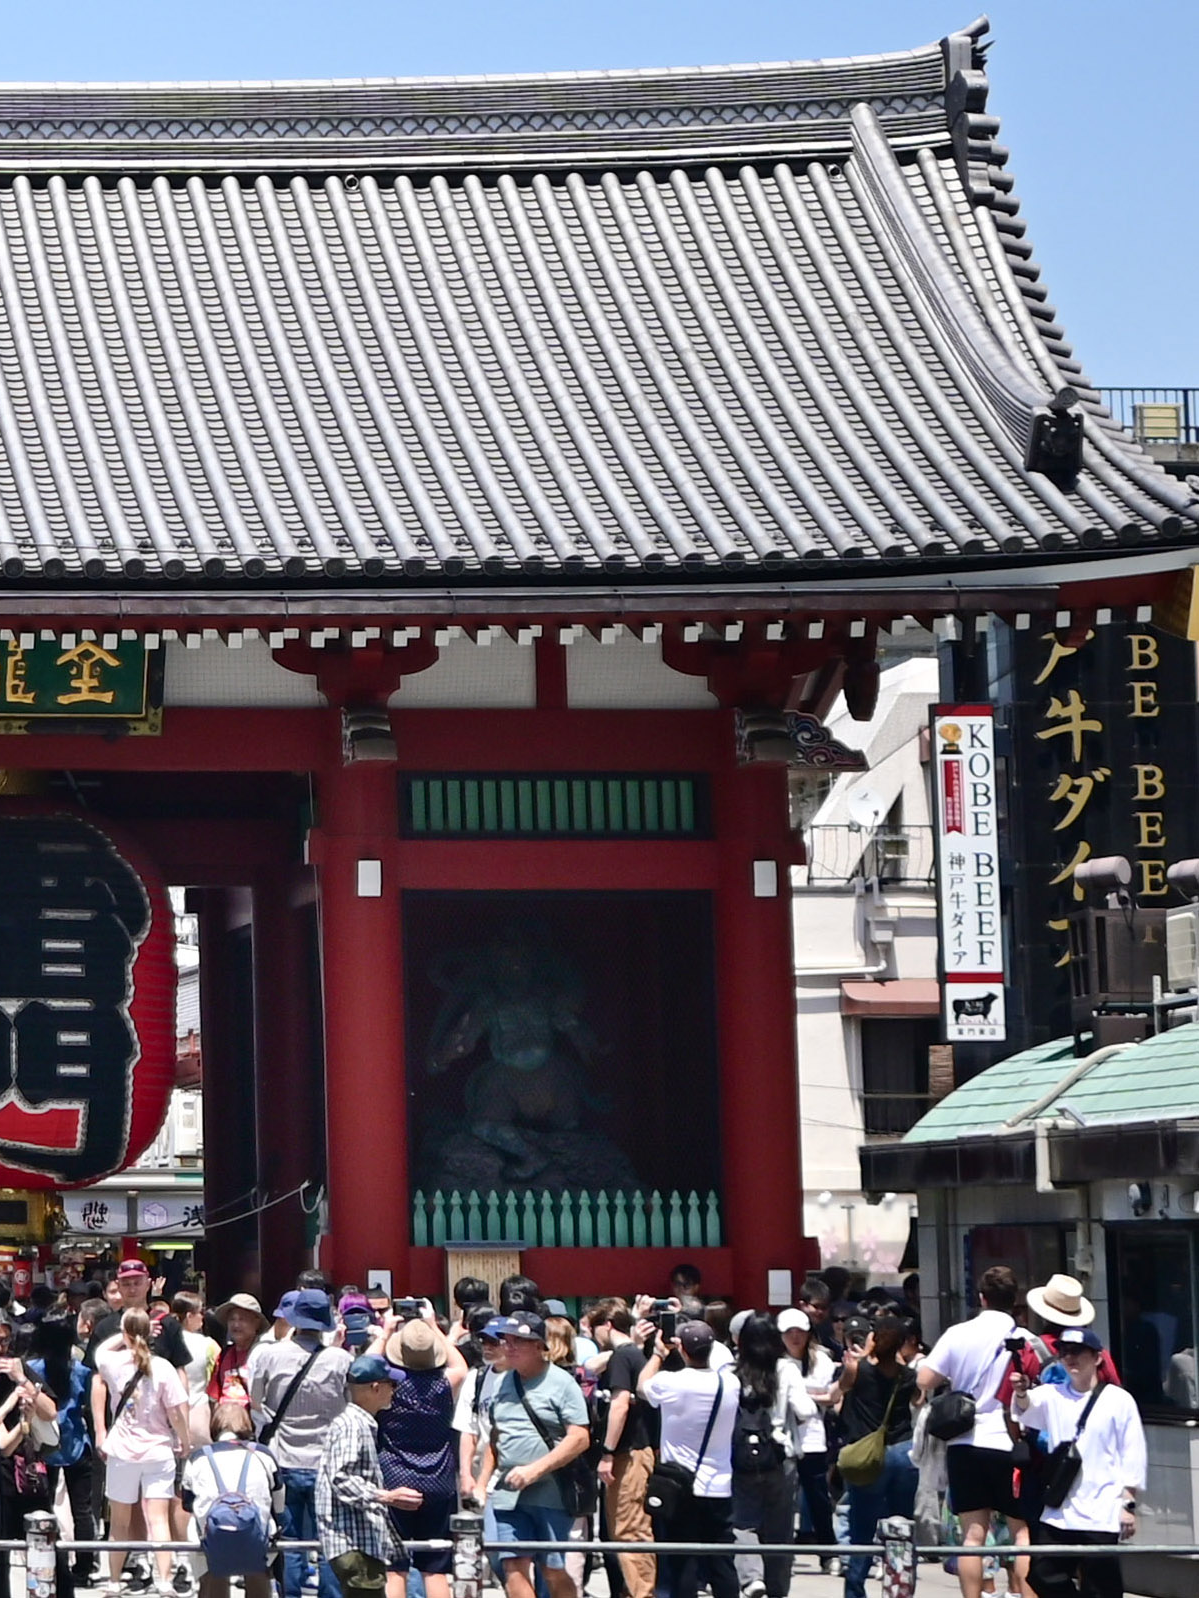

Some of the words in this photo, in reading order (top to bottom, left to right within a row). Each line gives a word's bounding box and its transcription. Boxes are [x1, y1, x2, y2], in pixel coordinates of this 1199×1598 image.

[967, 723, 992, 837] KOBE
[948, 852, 968, 966] 神戸牛ダイア
[973, 852, 996, 966] BEEF
